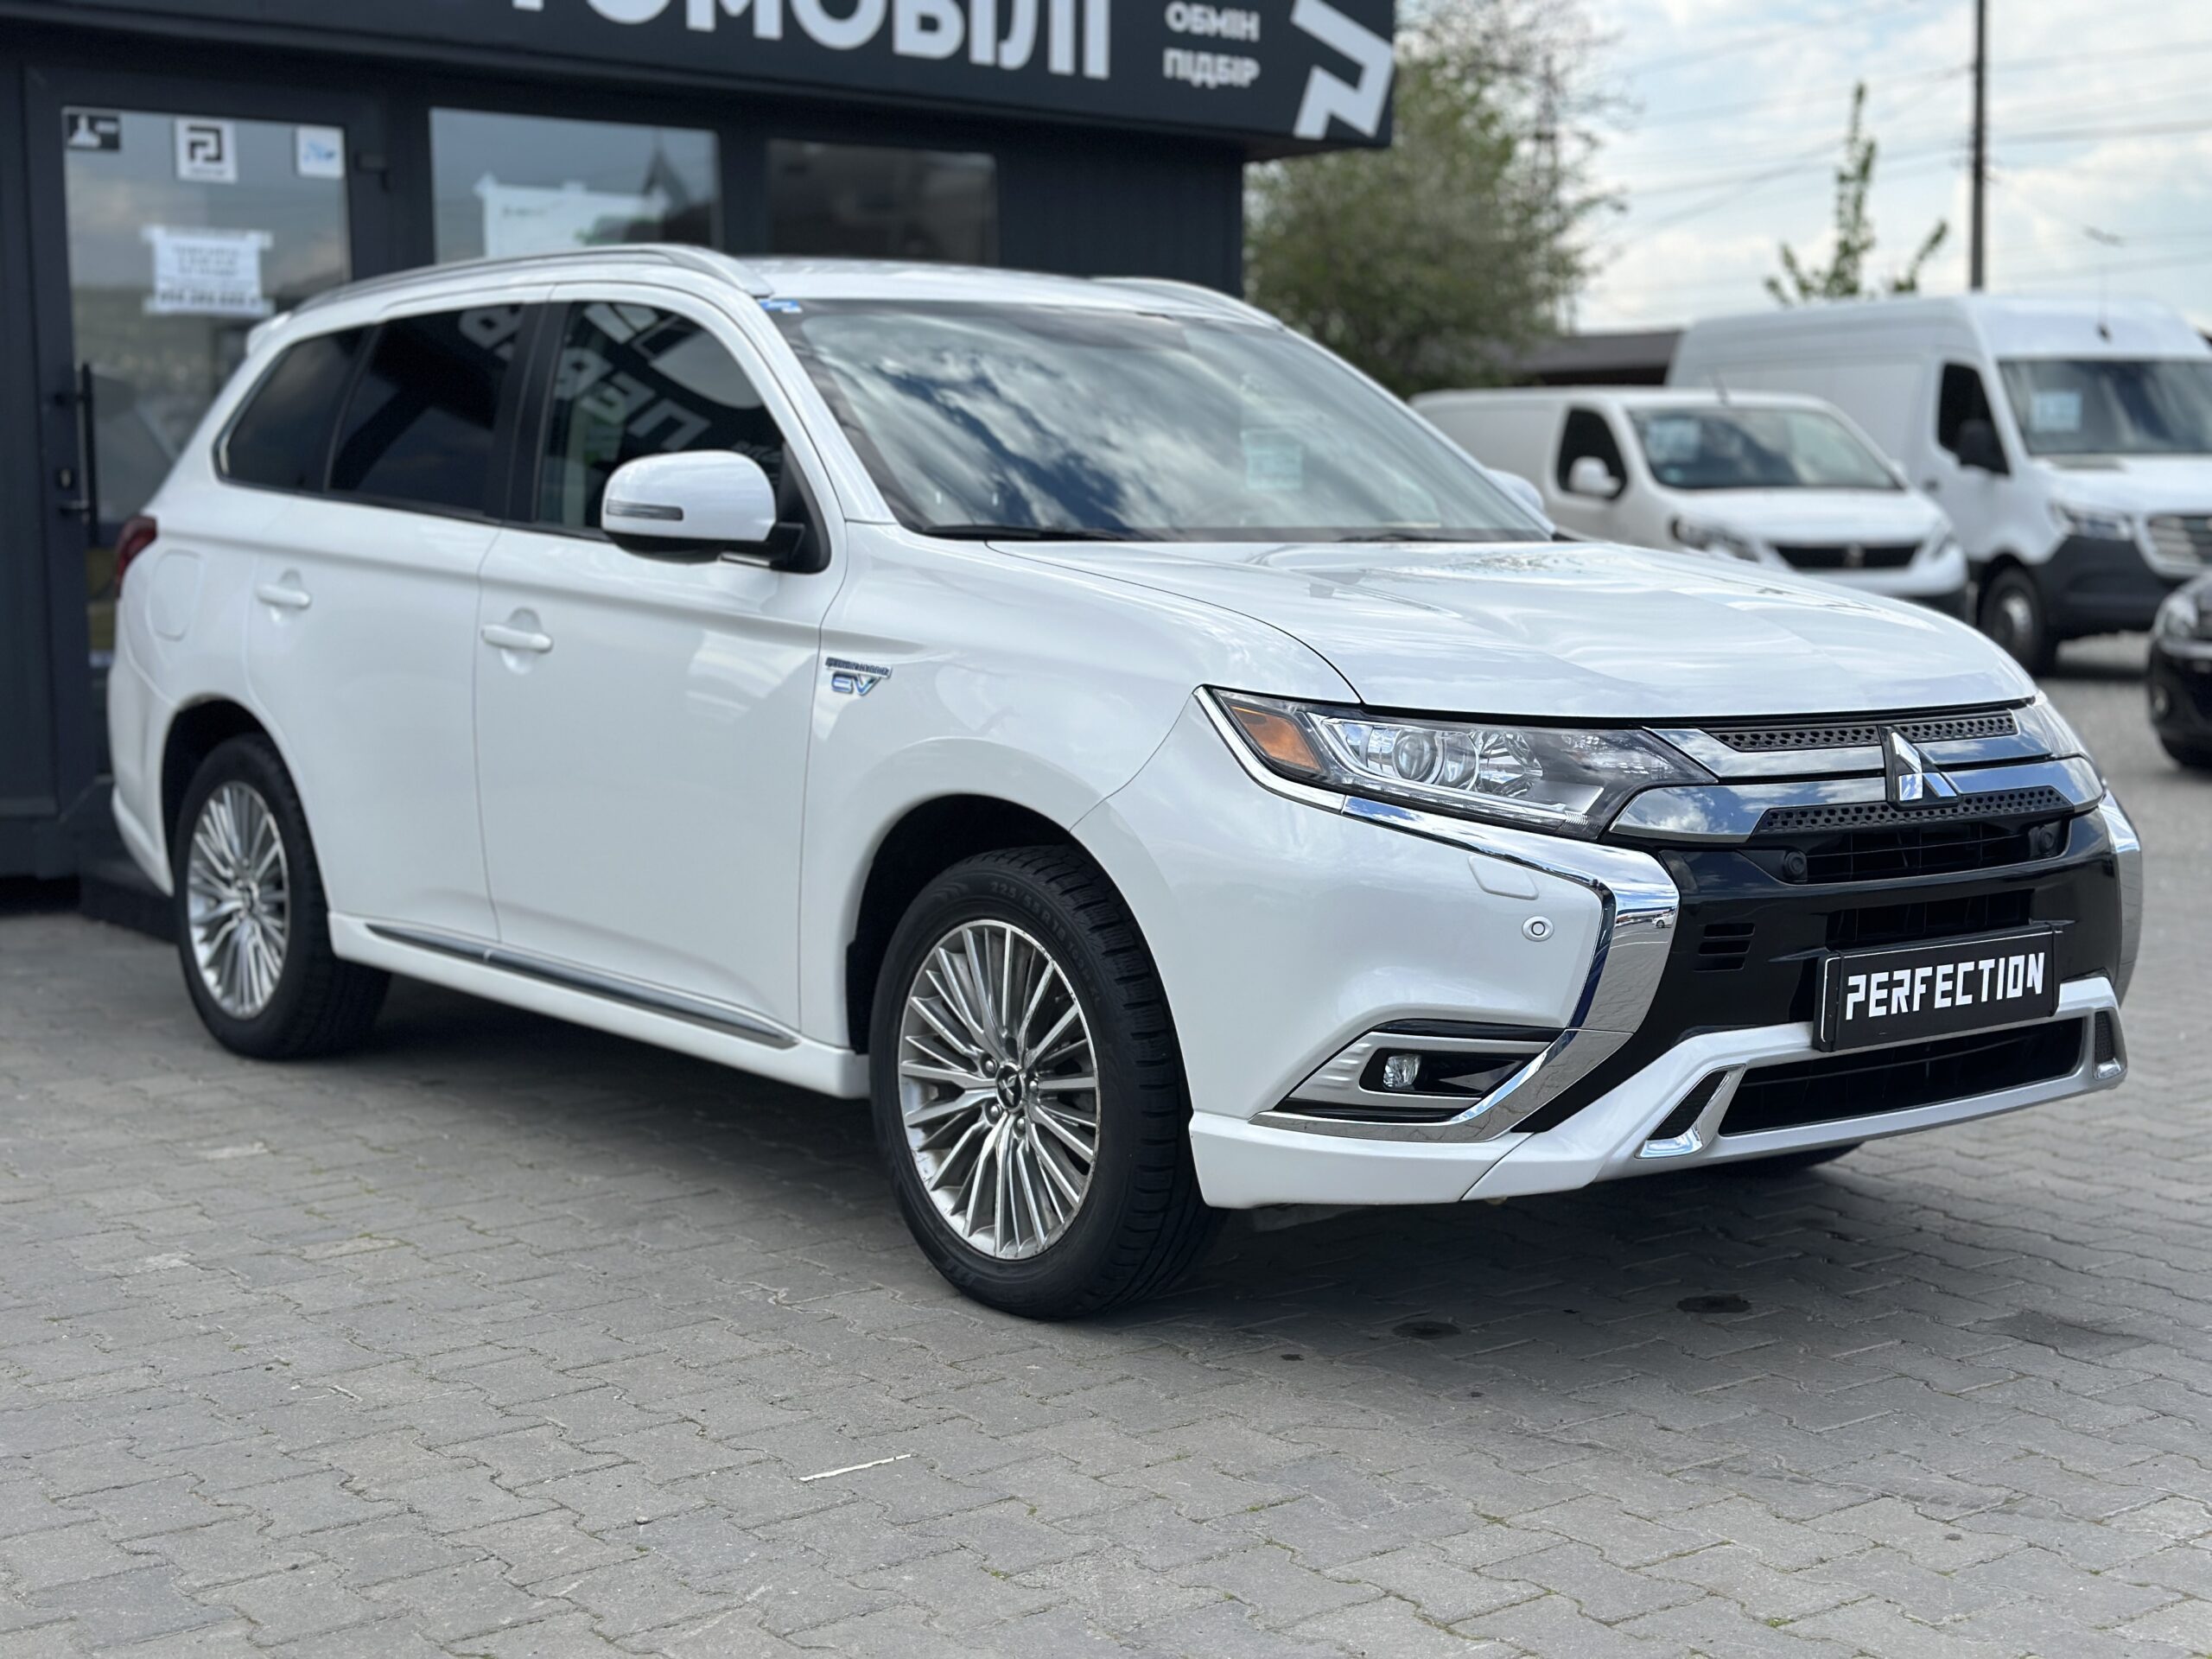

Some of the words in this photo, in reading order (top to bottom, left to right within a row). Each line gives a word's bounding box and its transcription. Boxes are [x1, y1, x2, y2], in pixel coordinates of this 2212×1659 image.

[1165, 2, 1261, 41] ОБМІН
[1163, 48, 1261, 88] ПІДБІР
[831, 671, 881, 695] EV
[1846, 952, 2045, 1020] PERFECTION
